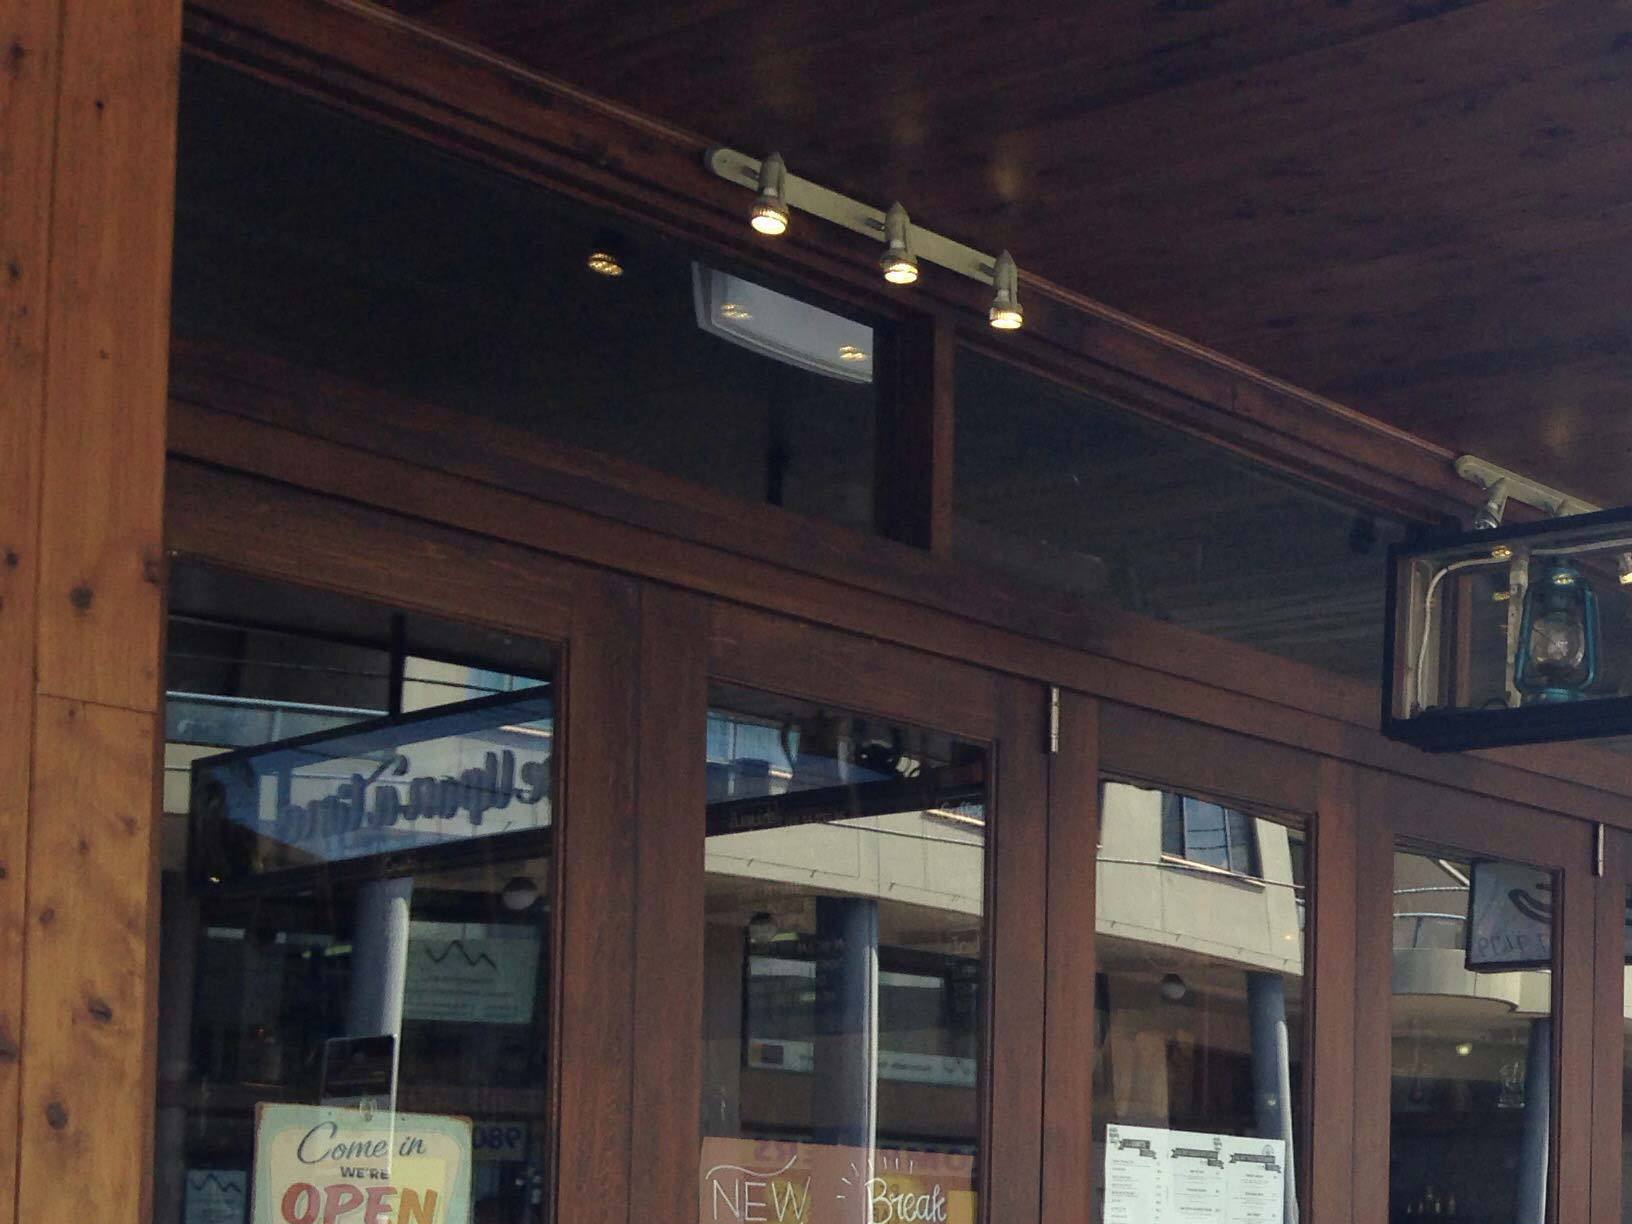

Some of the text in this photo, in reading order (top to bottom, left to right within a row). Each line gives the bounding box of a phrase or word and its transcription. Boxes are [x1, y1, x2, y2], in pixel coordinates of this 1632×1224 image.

[297, 1121, 426, 1164] Come in
[340, 1166, 390, 1180] WE'RE
[713, 1176, 811, 1222] NEW
